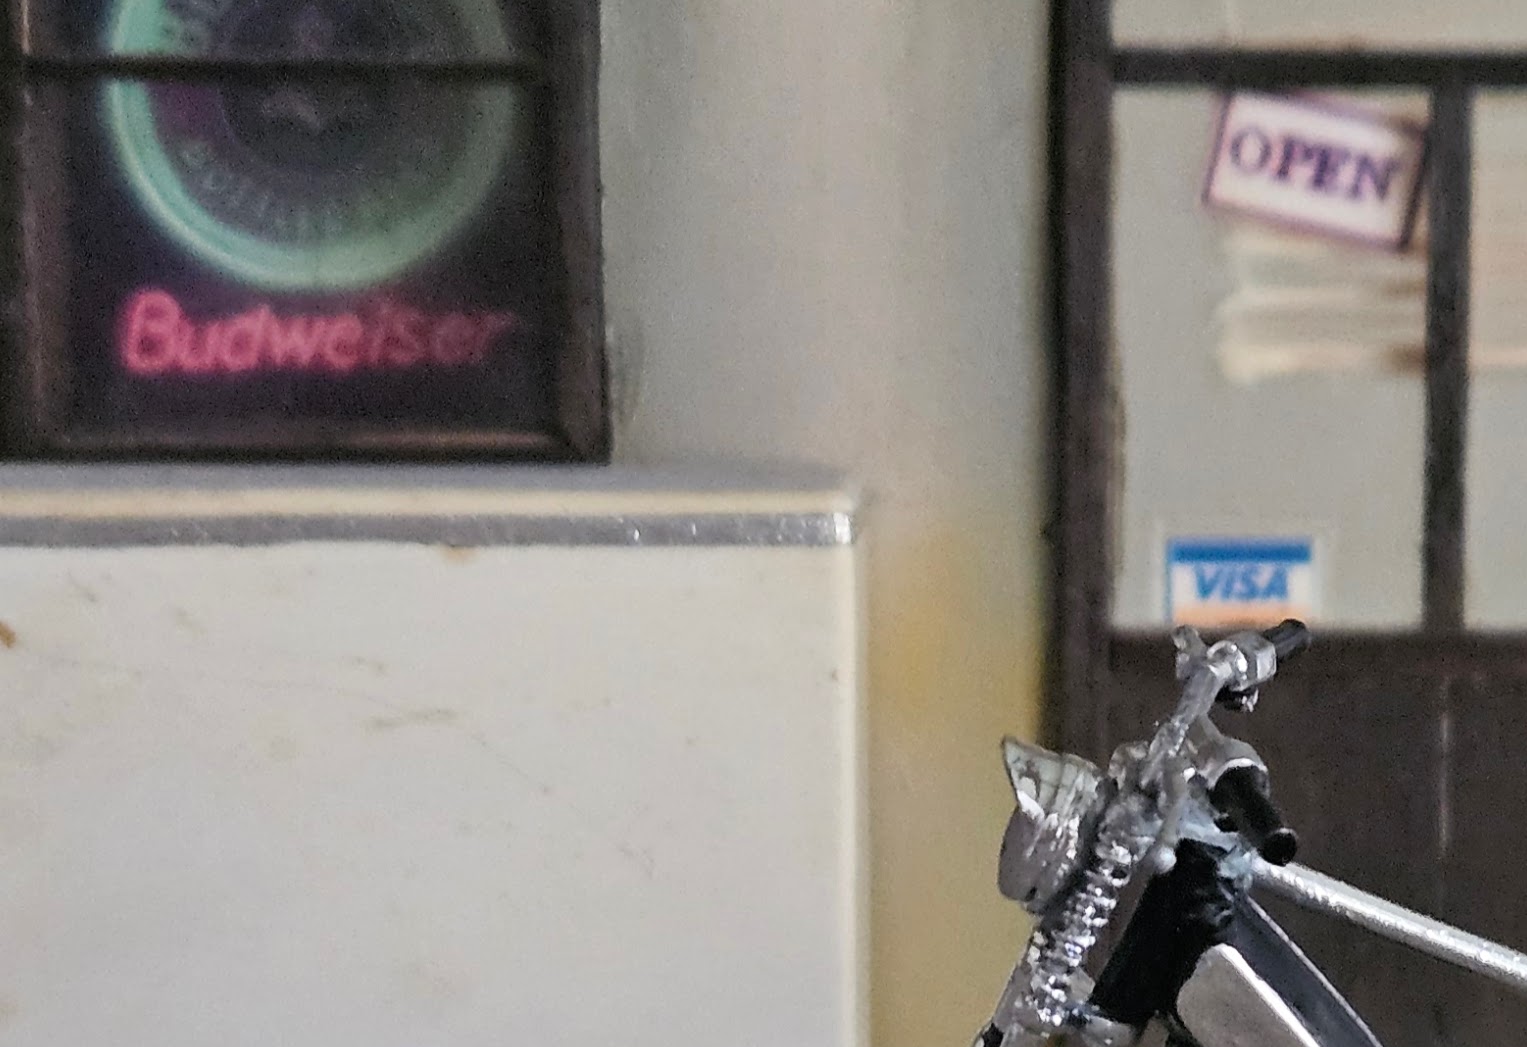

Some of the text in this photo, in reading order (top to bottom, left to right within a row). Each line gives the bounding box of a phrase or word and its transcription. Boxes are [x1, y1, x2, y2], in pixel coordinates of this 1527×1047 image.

[1229, 126, 1398, 200] OPEN
[121, 289, 514, 374] Budweiser
[1194, 566, 1290, 601] VISA
